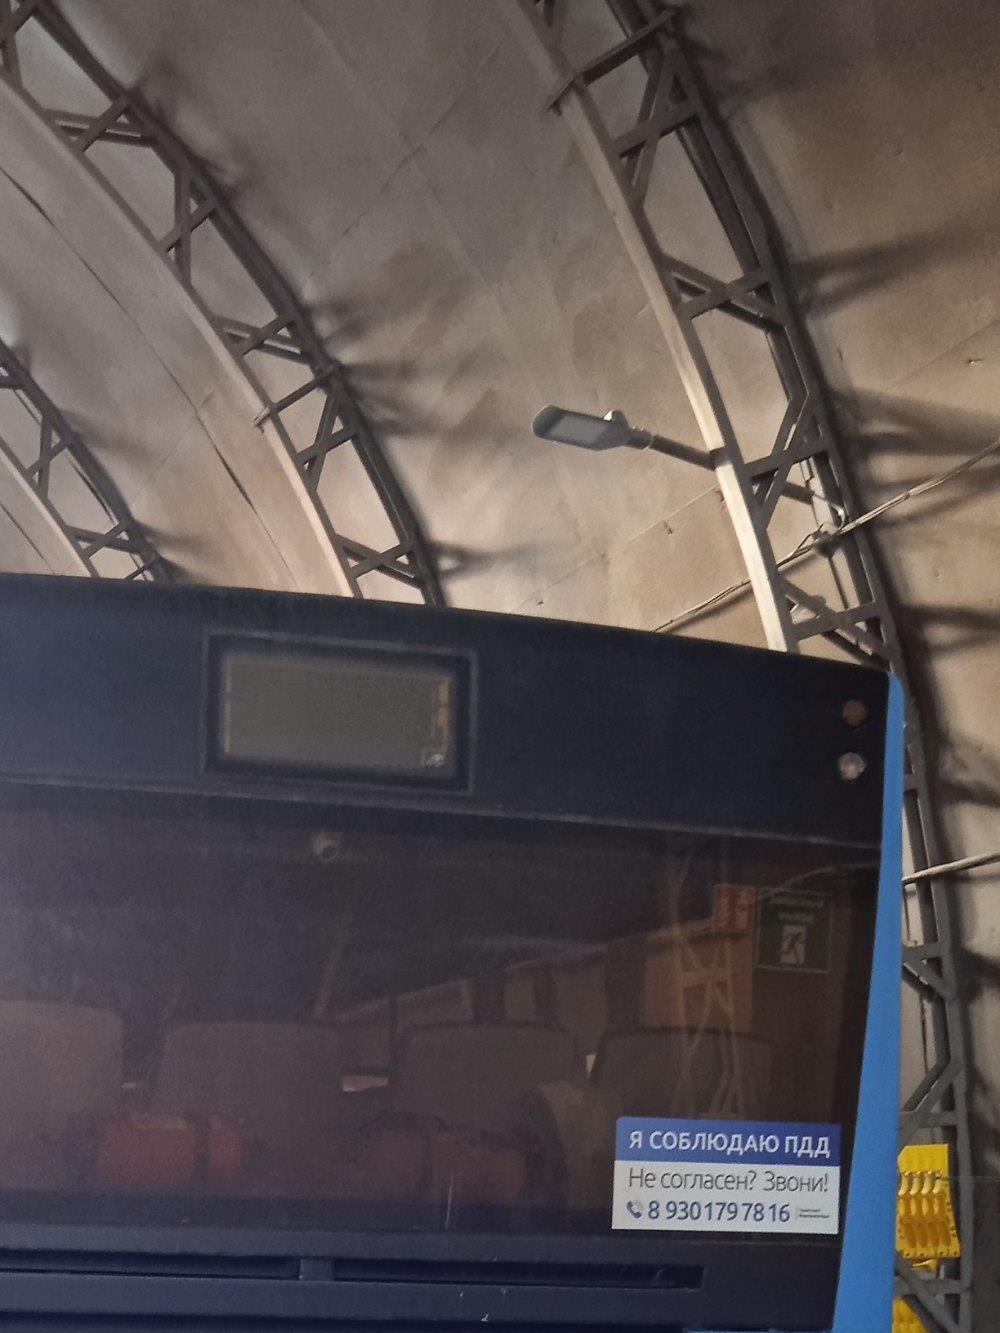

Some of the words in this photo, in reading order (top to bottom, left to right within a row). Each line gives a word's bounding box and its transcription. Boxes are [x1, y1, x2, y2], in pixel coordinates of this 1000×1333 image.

[629, 1131, 643, 1149] Я
[649, 1131, 779, 1155] СОБЛЮДАЮ
[784, 1136, 831, 1158] ПДД
[628, 1167, 656, 1188] Не
[660, 1171, 756, 1191] согласен?
[763, 1171, 829, 1192] Звони!
